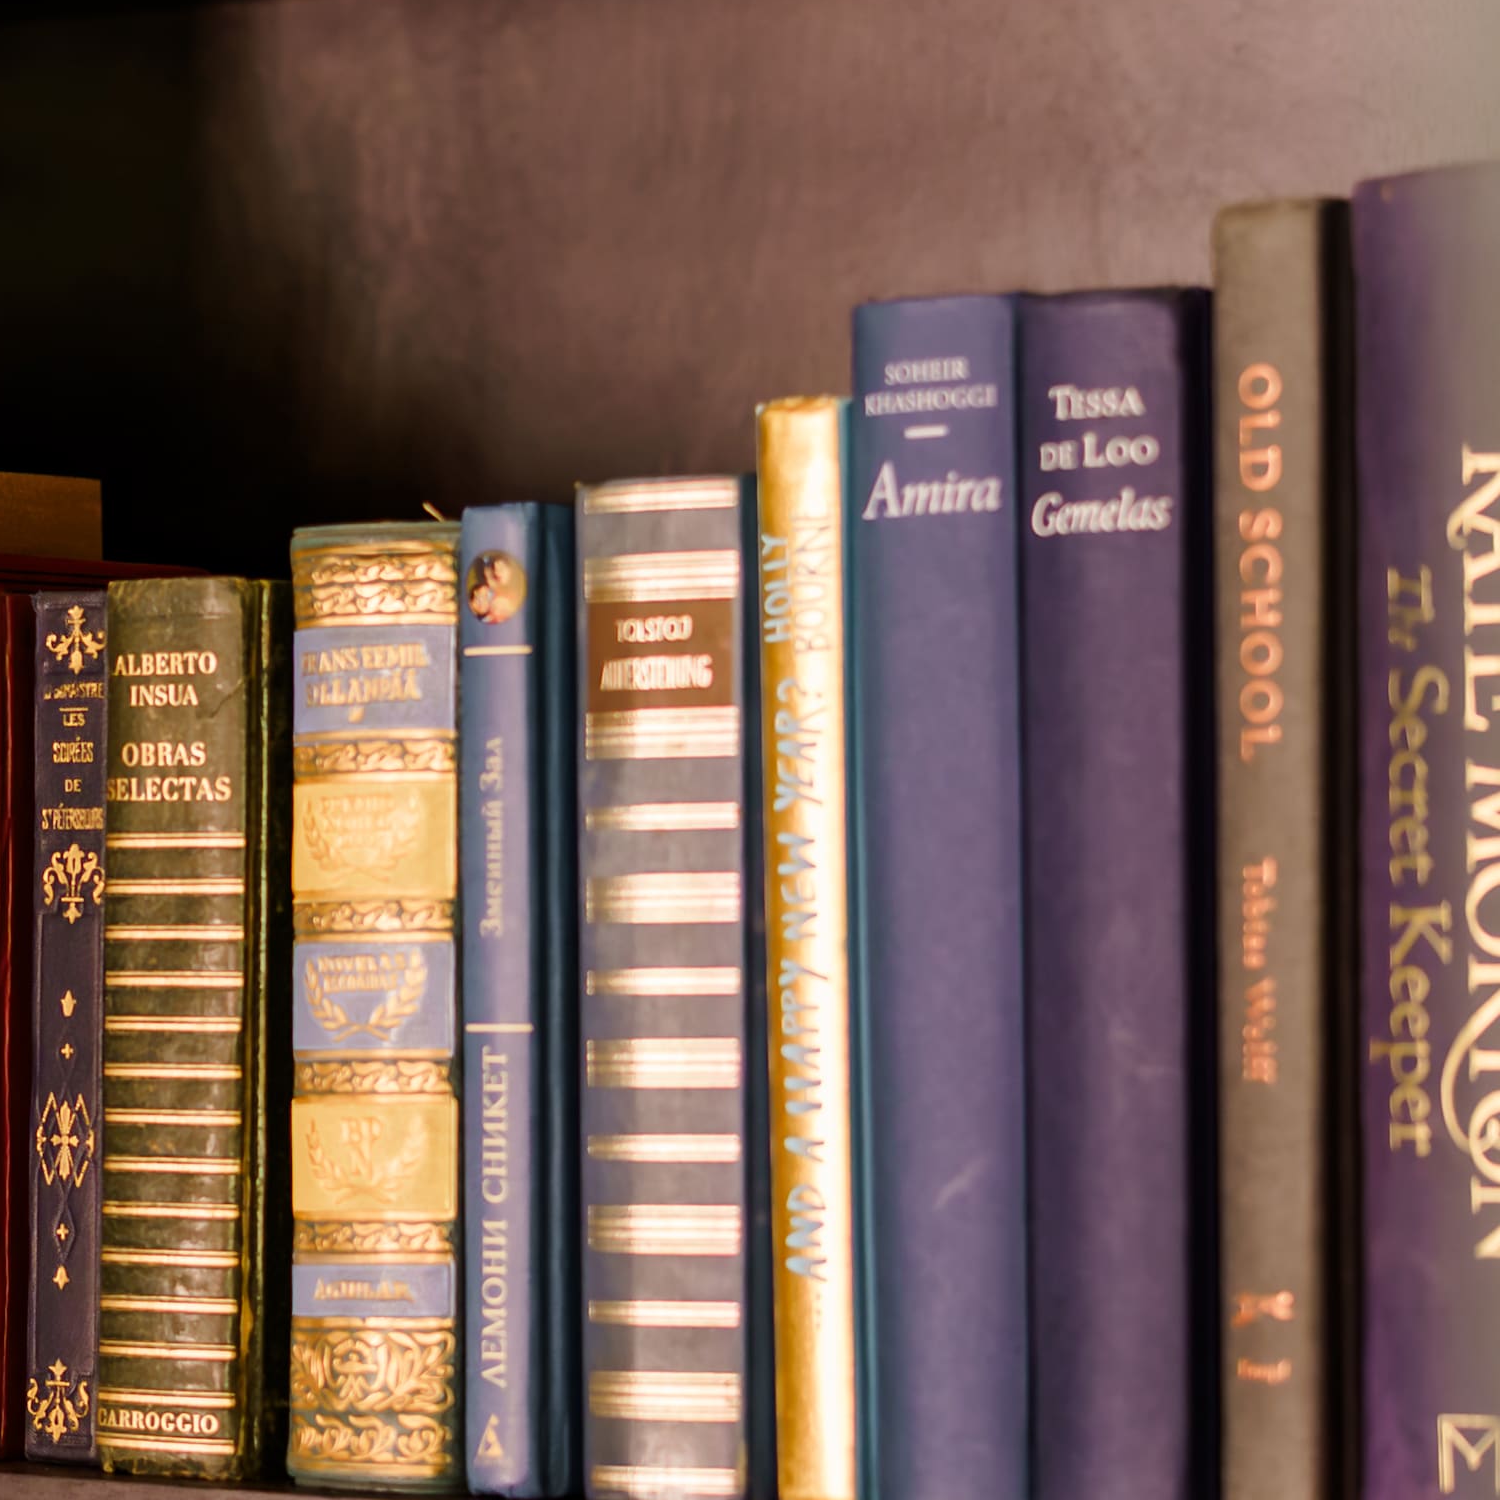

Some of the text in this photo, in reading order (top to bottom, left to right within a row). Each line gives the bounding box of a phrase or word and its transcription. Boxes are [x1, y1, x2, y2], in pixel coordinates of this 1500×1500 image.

[862, 460, 1001, 521] Amira
[1031, 486, 1173, 538] Gemelas
[1238, 363, 1285, 764] OLD SCHOOL
[760, 531, 791, 644] HOLLY
[114, 651, 218, 677] ALBERTO
[129, 683, 199, 707] INSUA
[63, 713, 86, 727] LES
[52, 736, 94, 763] SOIRÉES
[121, 741, 207, 767] OBRAS
[64, 779, 82, 793] DE
[106, 776, 232, 802] SELECTAS
[1387, 664, 1450, 886] Secret
[777, 831, 818, 941] NEW
[1369, 901, 1453, 1158] Keeper
[480, 1045, 509, 1388] ЛЕМОНИ СНИКЕТ
[98, 1408, 219, 1434] CARROGGIO
